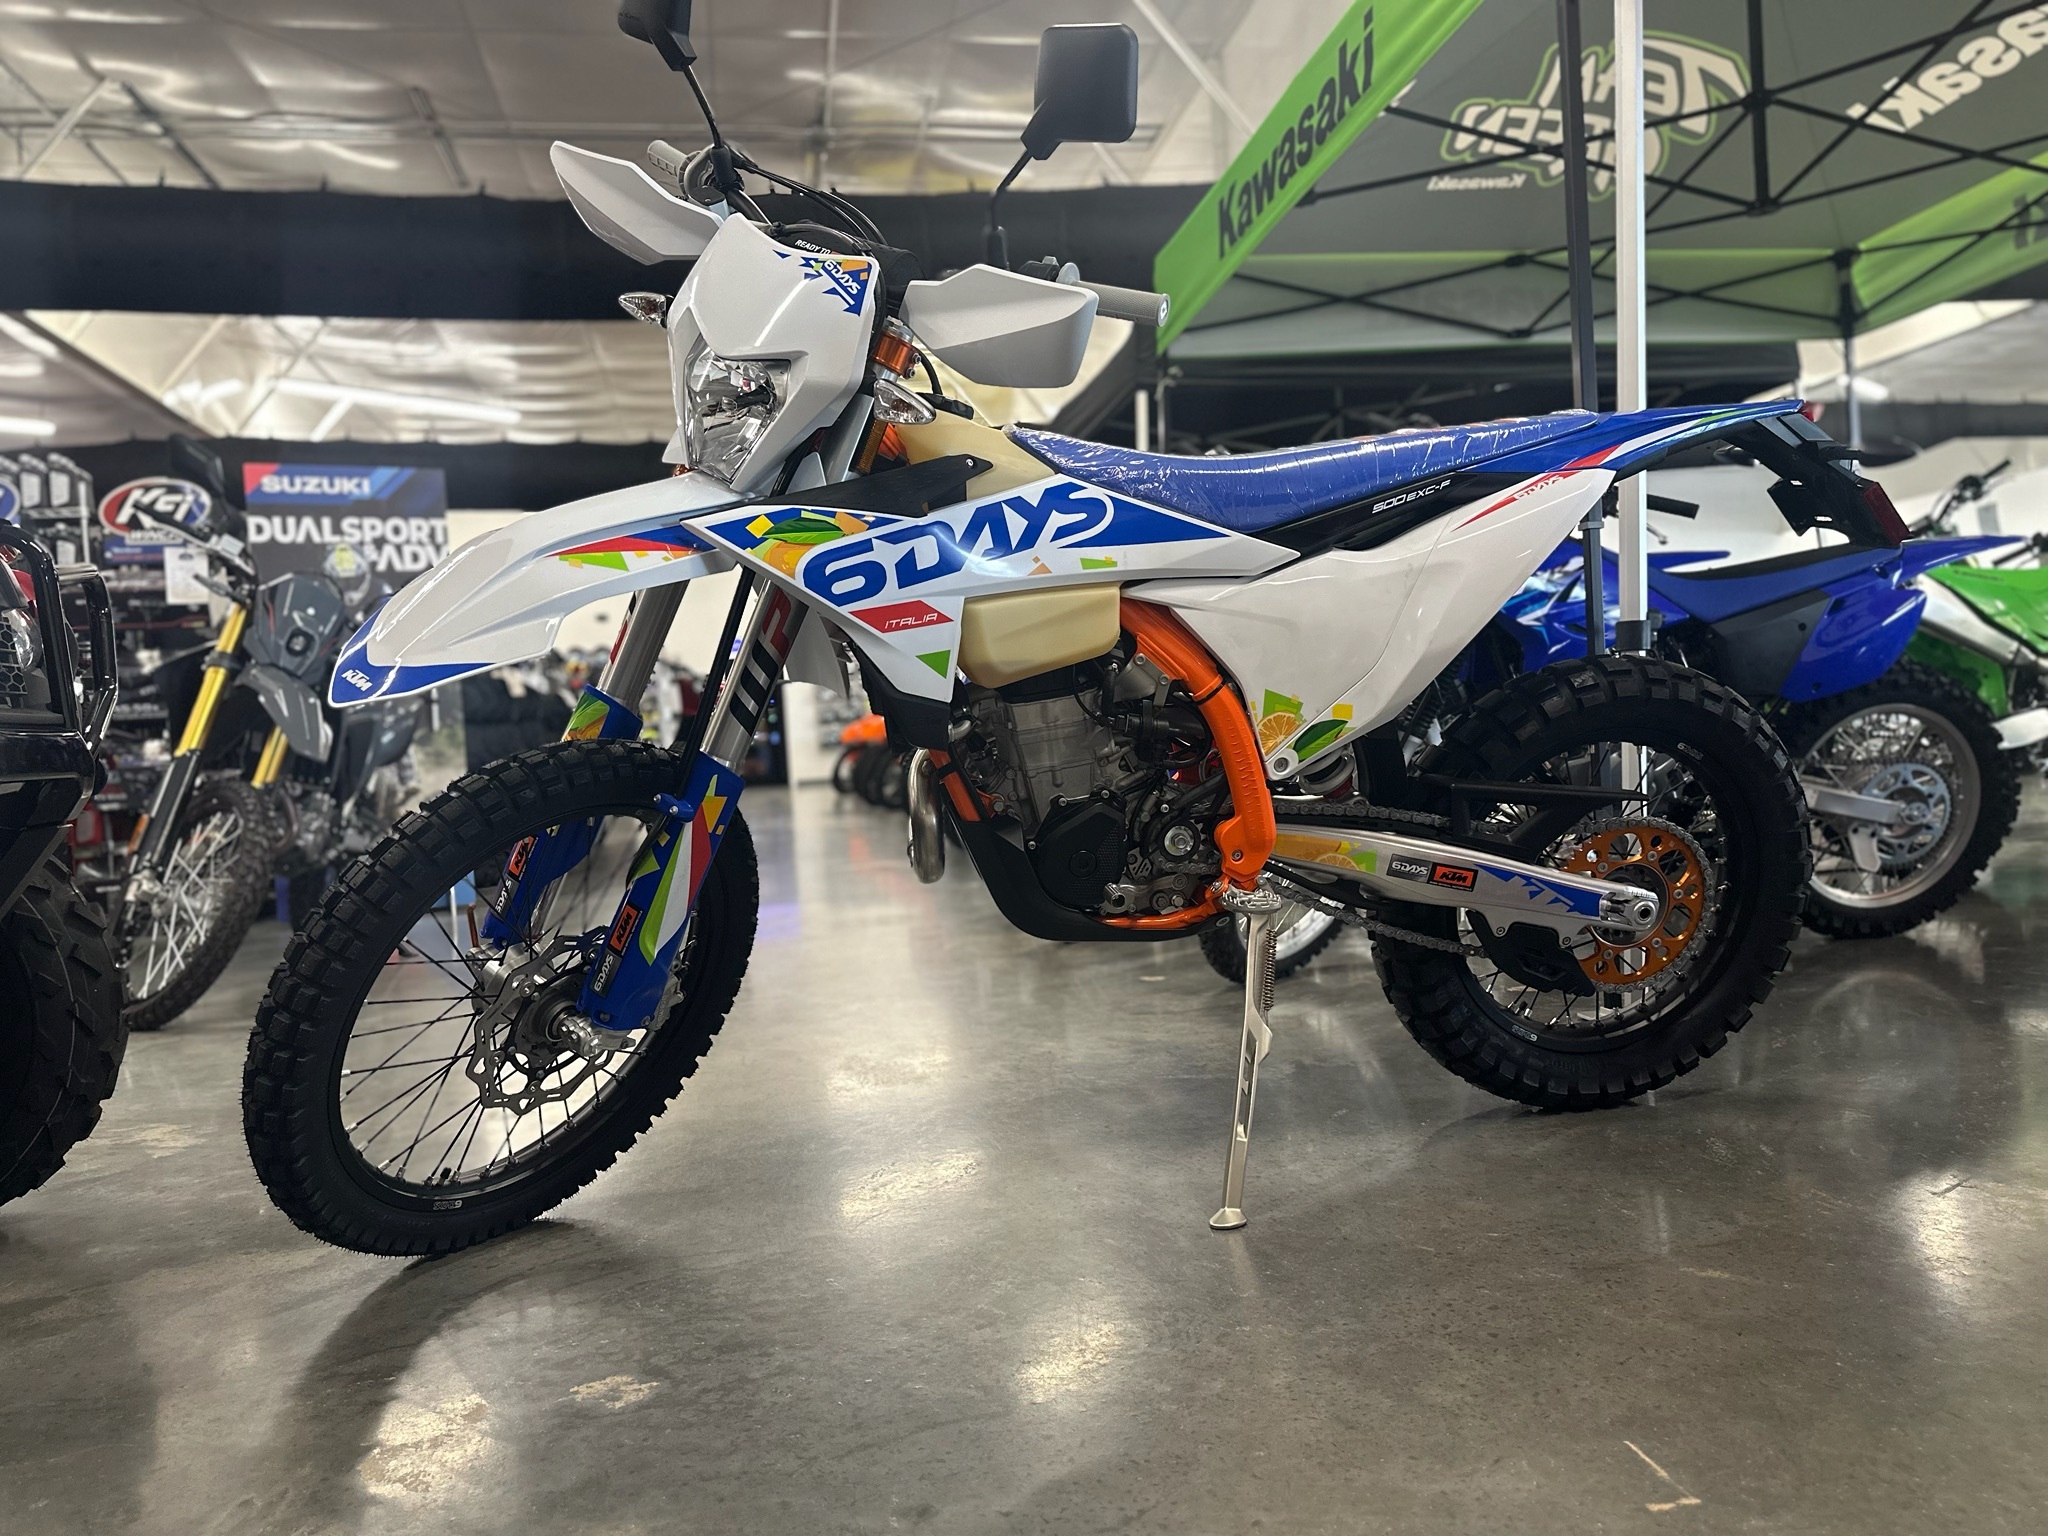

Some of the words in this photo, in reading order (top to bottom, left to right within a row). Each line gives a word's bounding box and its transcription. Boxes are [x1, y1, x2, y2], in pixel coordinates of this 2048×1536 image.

[1217, 4, 1374, 260] Kawasaki
[795, 239, 820, 252] READY
[824, 259, 862, 295] 6DAYS
[260, 475, 371, 495] SUZUKI
[803, 481, 1107, 607] 6DAYS
[884, 612, 938, 630] ITALIA
[340, 669, 374, 692] KTM
[1391, 861, 1429, 876] 6DAYS
[1439, 870, 1469, 884] KTM
[616, 911, 633, 945] KTM
[593, 954, 614, 993] 6DAYS
